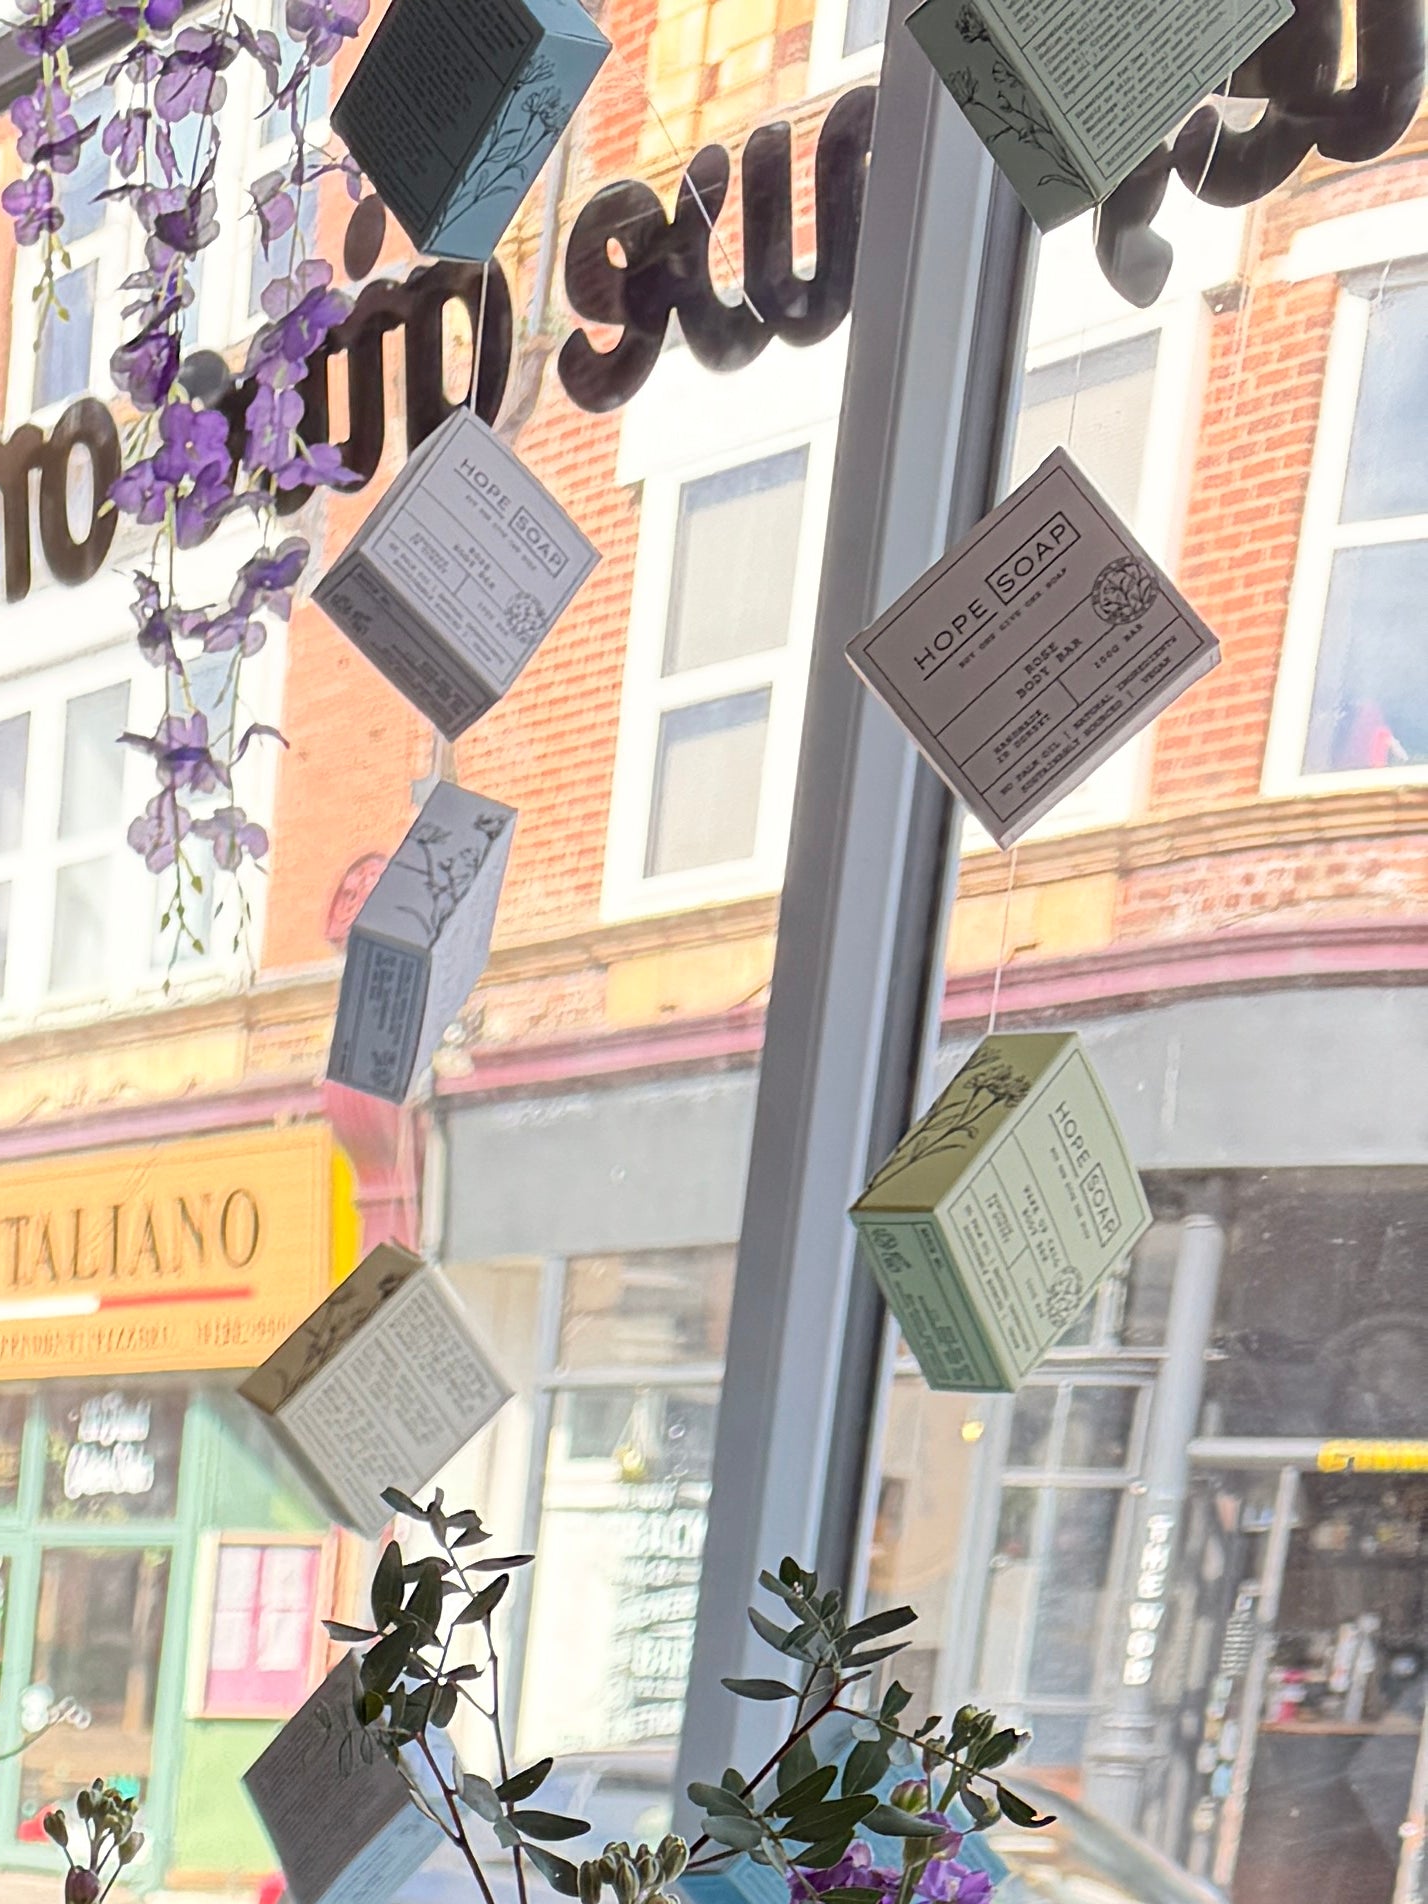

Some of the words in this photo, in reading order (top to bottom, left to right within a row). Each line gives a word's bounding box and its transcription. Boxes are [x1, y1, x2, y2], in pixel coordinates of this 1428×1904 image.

[913, 598, 989, 671] HOPE
[996, 523, 1066, 593] SOAP
[1054, 1101, 1092, 1169] HOPE
